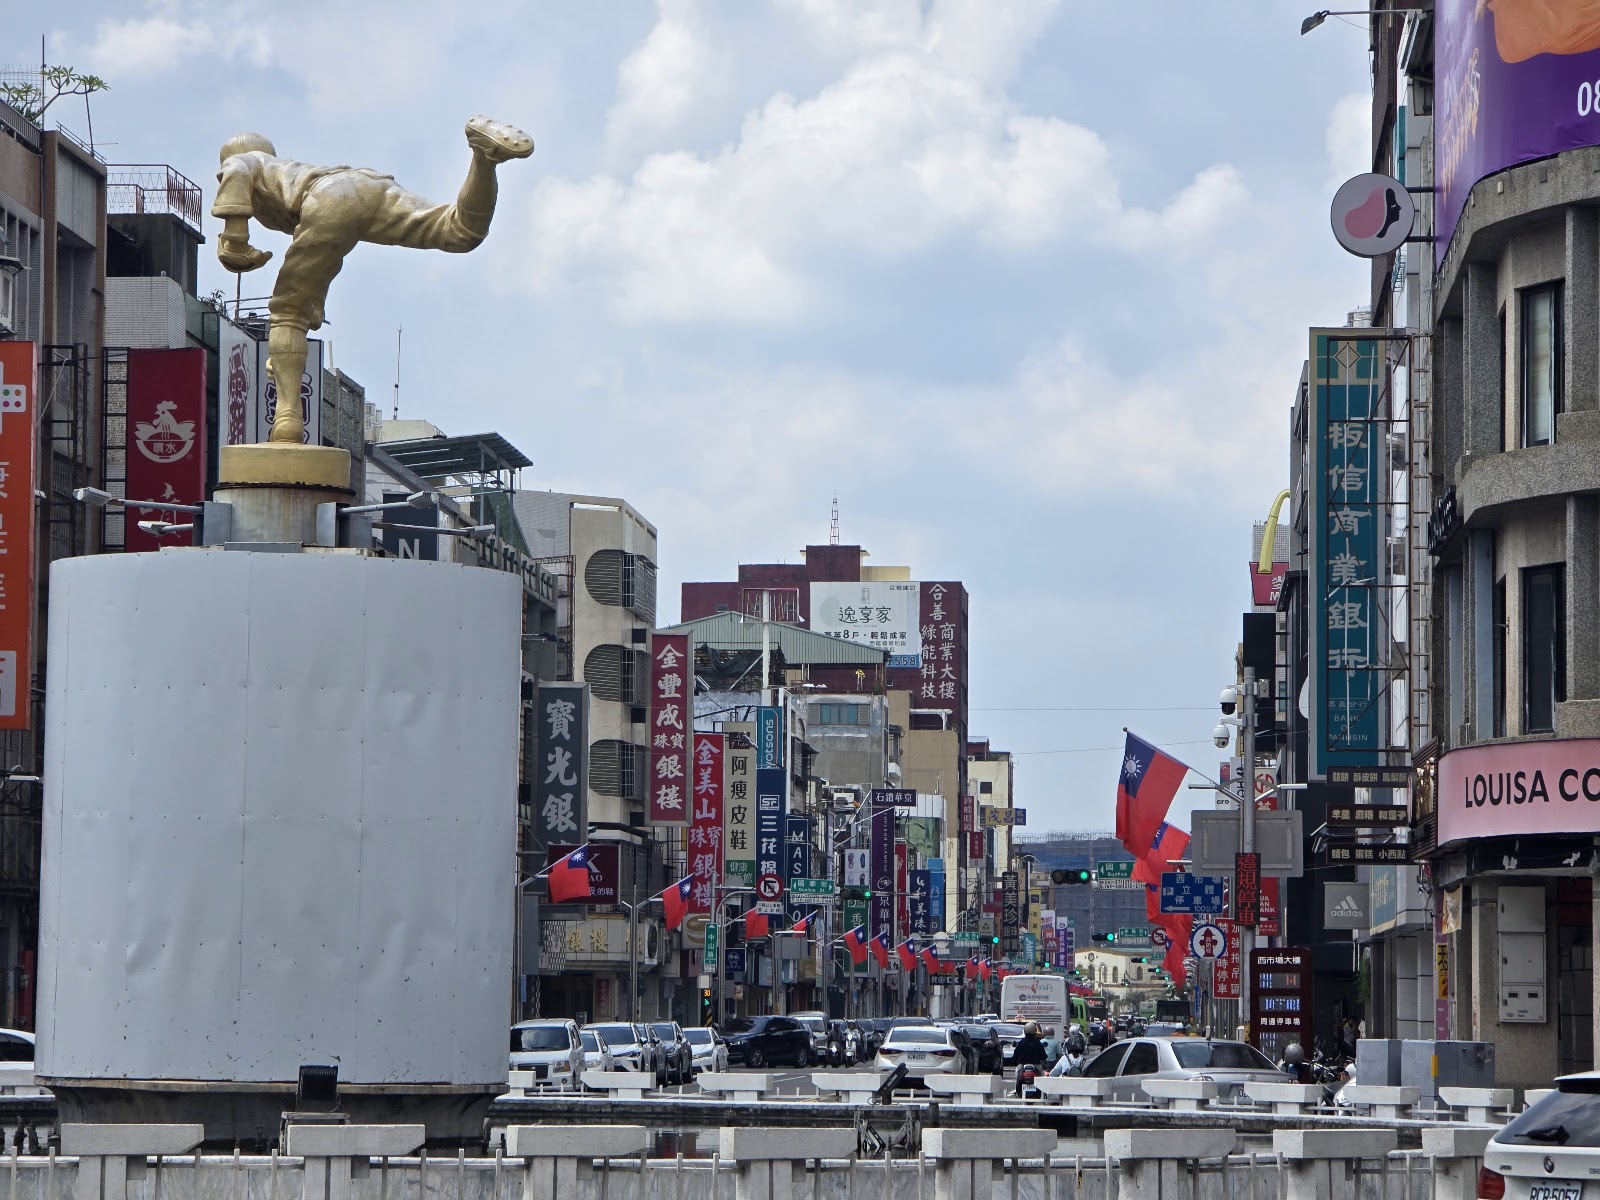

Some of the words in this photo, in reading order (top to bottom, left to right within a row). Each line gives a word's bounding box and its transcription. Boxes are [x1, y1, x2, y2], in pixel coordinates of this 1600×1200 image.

[838, 606, 892, 624] 逸享家
[929, 583, 948, 621] 合善
[920, 623, 938, 699] 綠能科技
[939, 622, 957, 700] 商業大樓
[1333, 714, 1361, 723] BANK
[541, 698, 578, 846] 寶光銀
[1465, 769, 1550, 809] LOUISA
[730, 755, 748, 850] 阿瘦皮鞋
[1174, 895, 1221, 906] 停車場
[1236, 853, 1258, 926] 違規停車
[1330, 908, 1364, 918] adidas
[707, 933, 715, 958] 中山路
[1257, 956, 1301, 966] 西市場大樓
